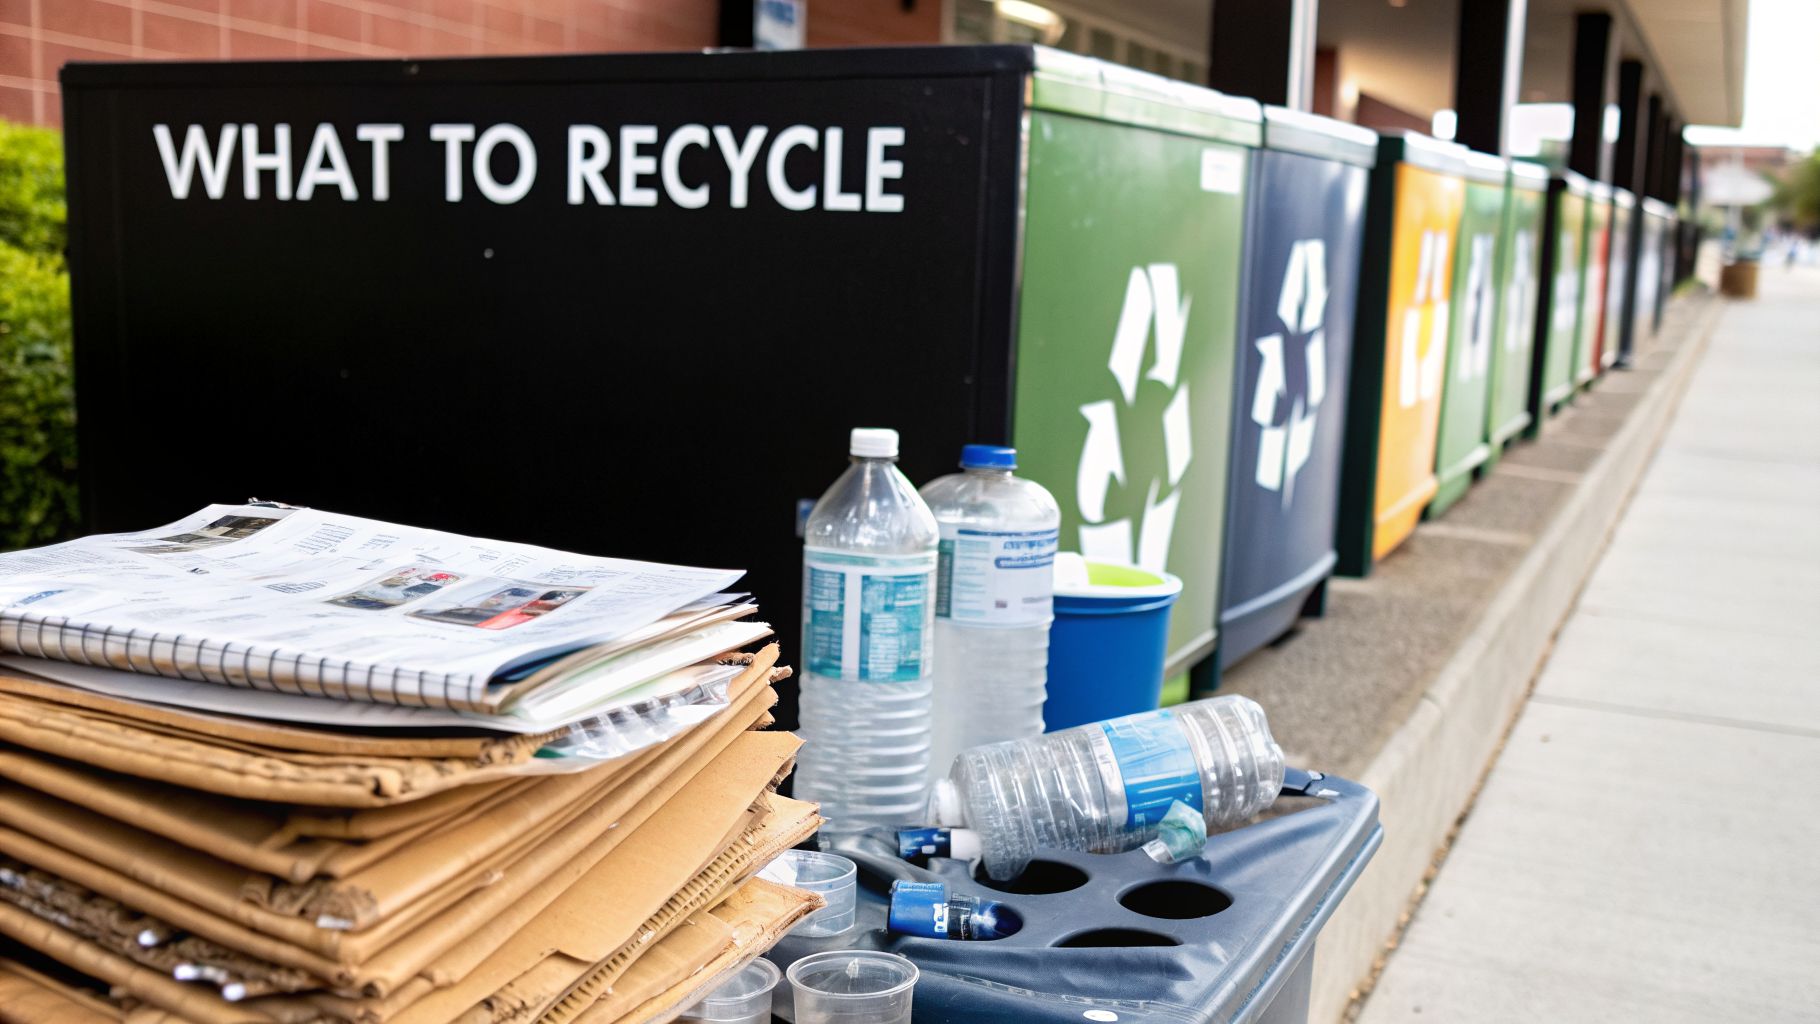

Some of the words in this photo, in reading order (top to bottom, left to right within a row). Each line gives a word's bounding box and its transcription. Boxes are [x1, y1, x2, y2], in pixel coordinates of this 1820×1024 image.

[153, 123, 404, 201] WHAT
[430, 123, 537, 205] TO
[567, 124, 906, 213] RECYCLE
